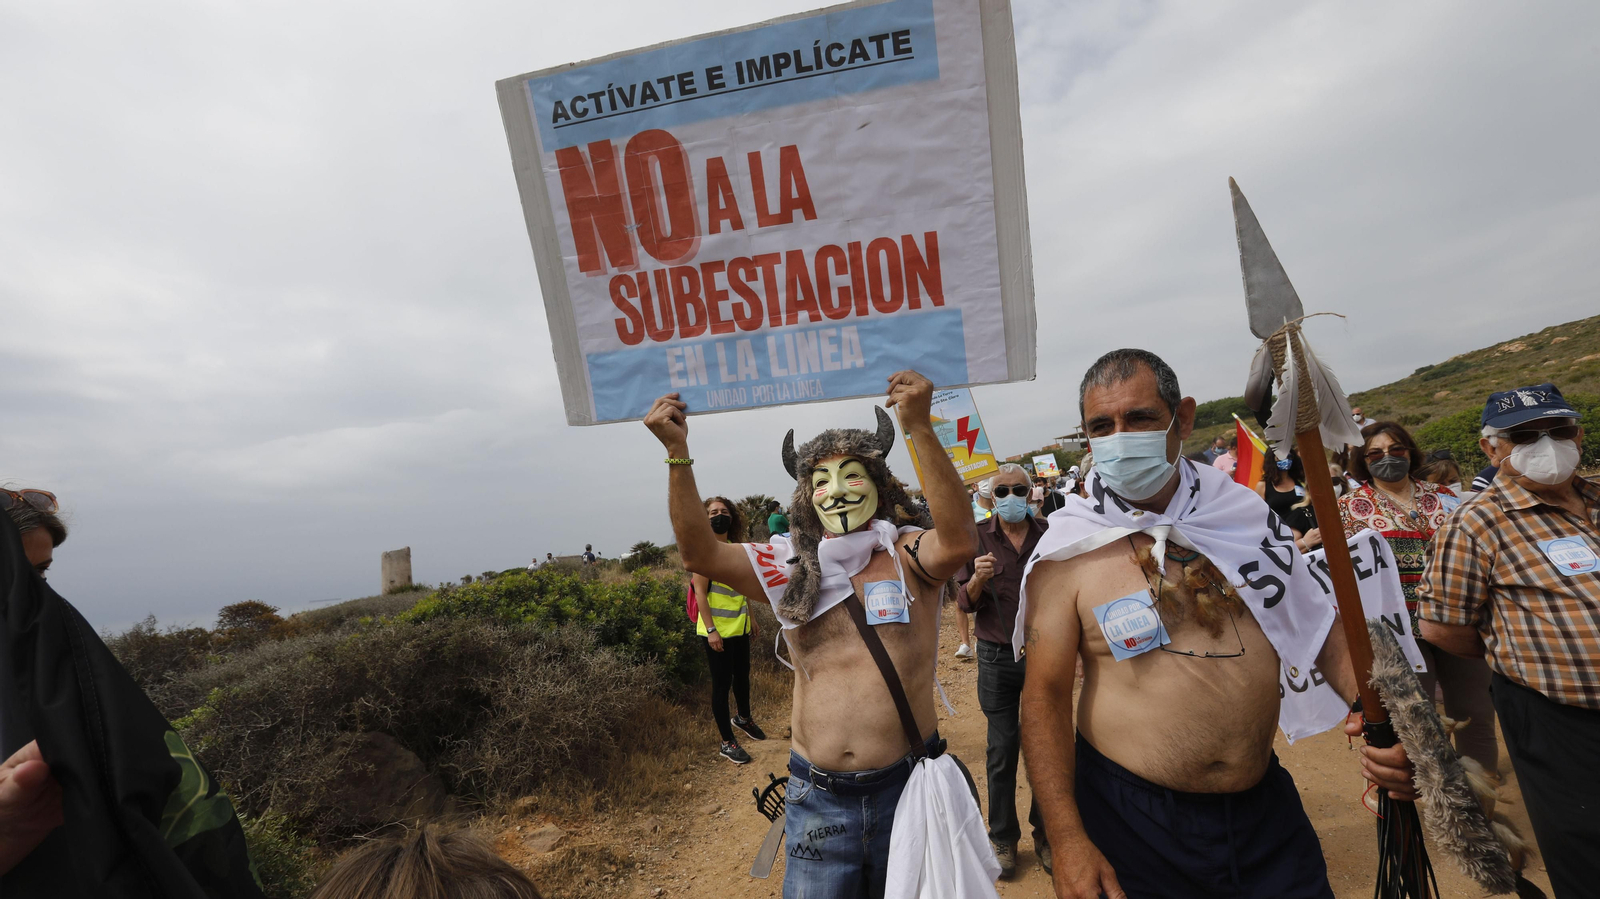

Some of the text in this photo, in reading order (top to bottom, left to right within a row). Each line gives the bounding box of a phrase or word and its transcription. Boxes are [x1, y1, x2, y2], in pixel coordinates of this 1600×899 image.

[552, 29, 913, 124] ACTÍVATE E IMPLÍCATE
[555, 128, 818, 277] NO A LA
[608, 231, 945, 346] SUBESTACION
[666, 325, 865, 388] EN LA LINEA
[706, 377, 825, 408] UNIDAD POR LA LÍNEA
[1496, 391, 1552, 412] N Y
[1568, 562, 1581, 570] NO
[871, 598, 880, 608] LA
[878, 609, 887, 618] NO
[1109, 602, 1141, 619] UNIDAD POR
[1109, 614, 1150, 637] LA LÍNEA
[1124, 637, 1137, 649] NO
[807, 824, 847, 843] TIERRA
